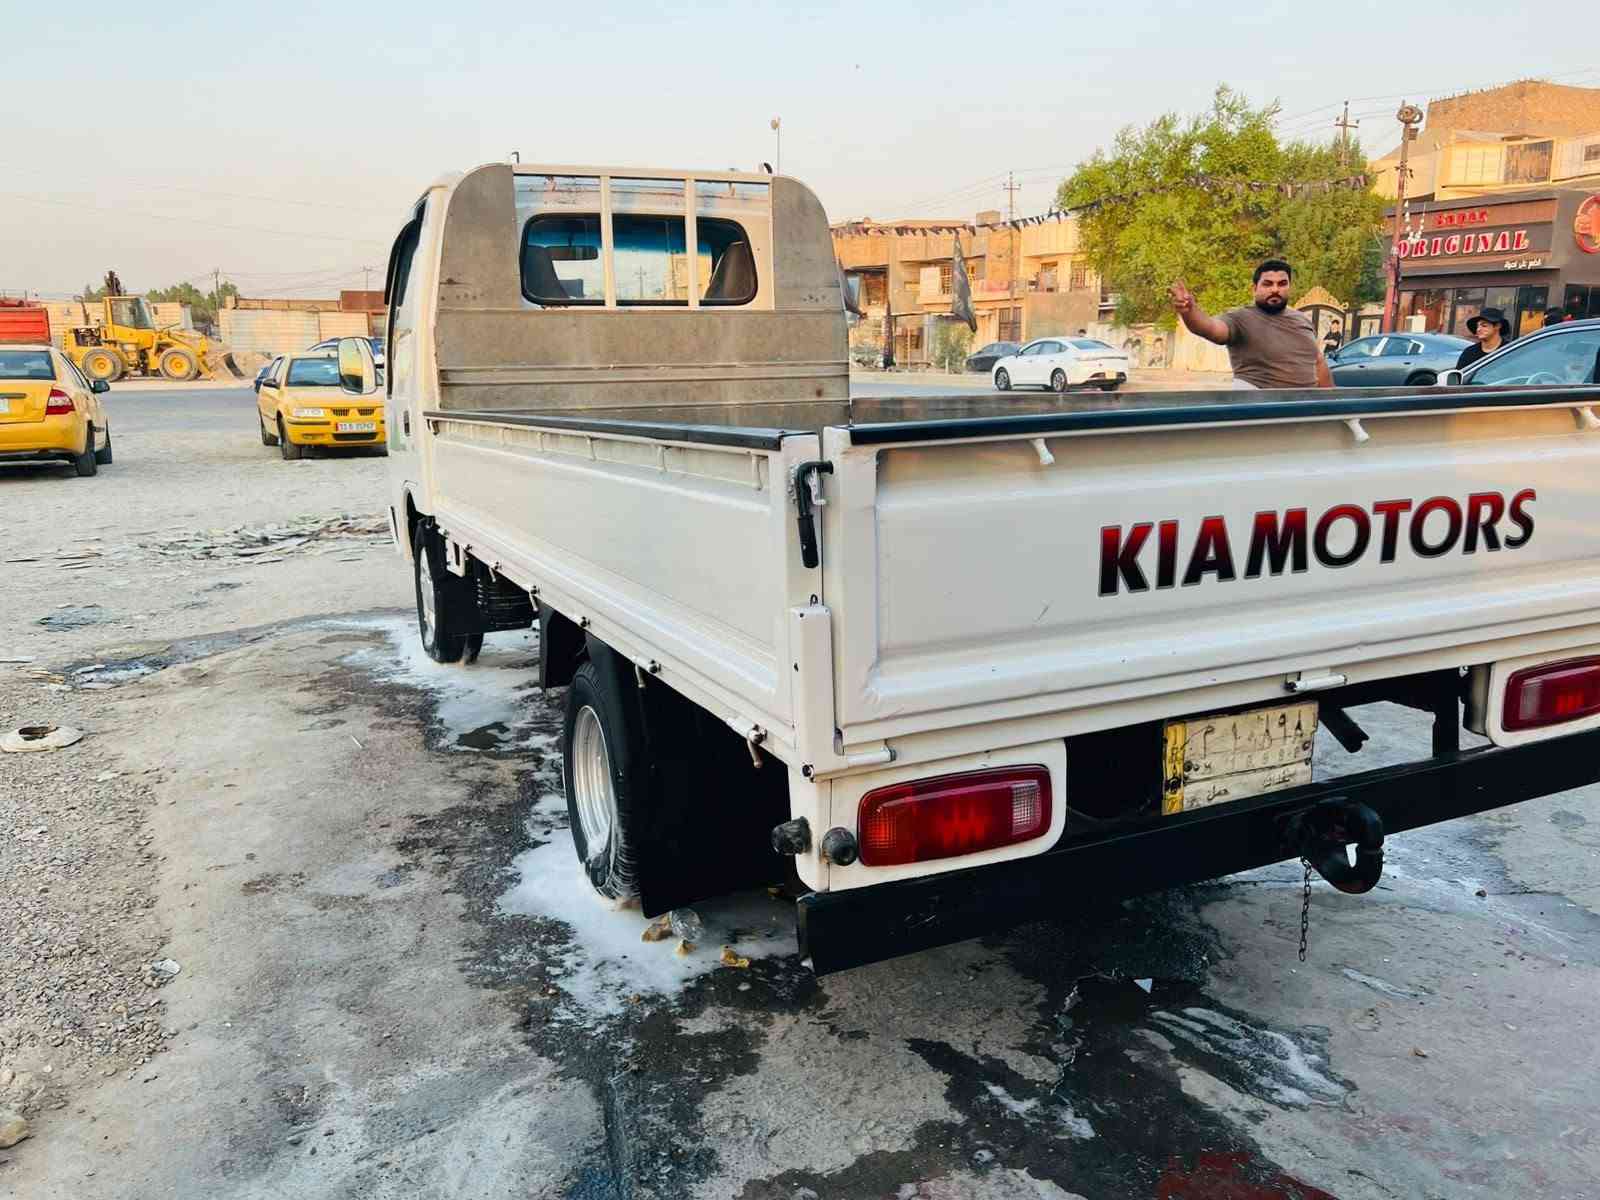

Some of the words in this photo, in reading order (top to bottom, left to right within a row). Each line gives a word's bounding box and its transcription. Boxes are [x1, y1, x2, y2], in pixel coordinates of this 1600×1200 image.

[1398, 230, 1529, 258] ORIGINAL
[1097, 515, 1236, 597] KIA
[1244, 488, 1536, 579] MOTORS
